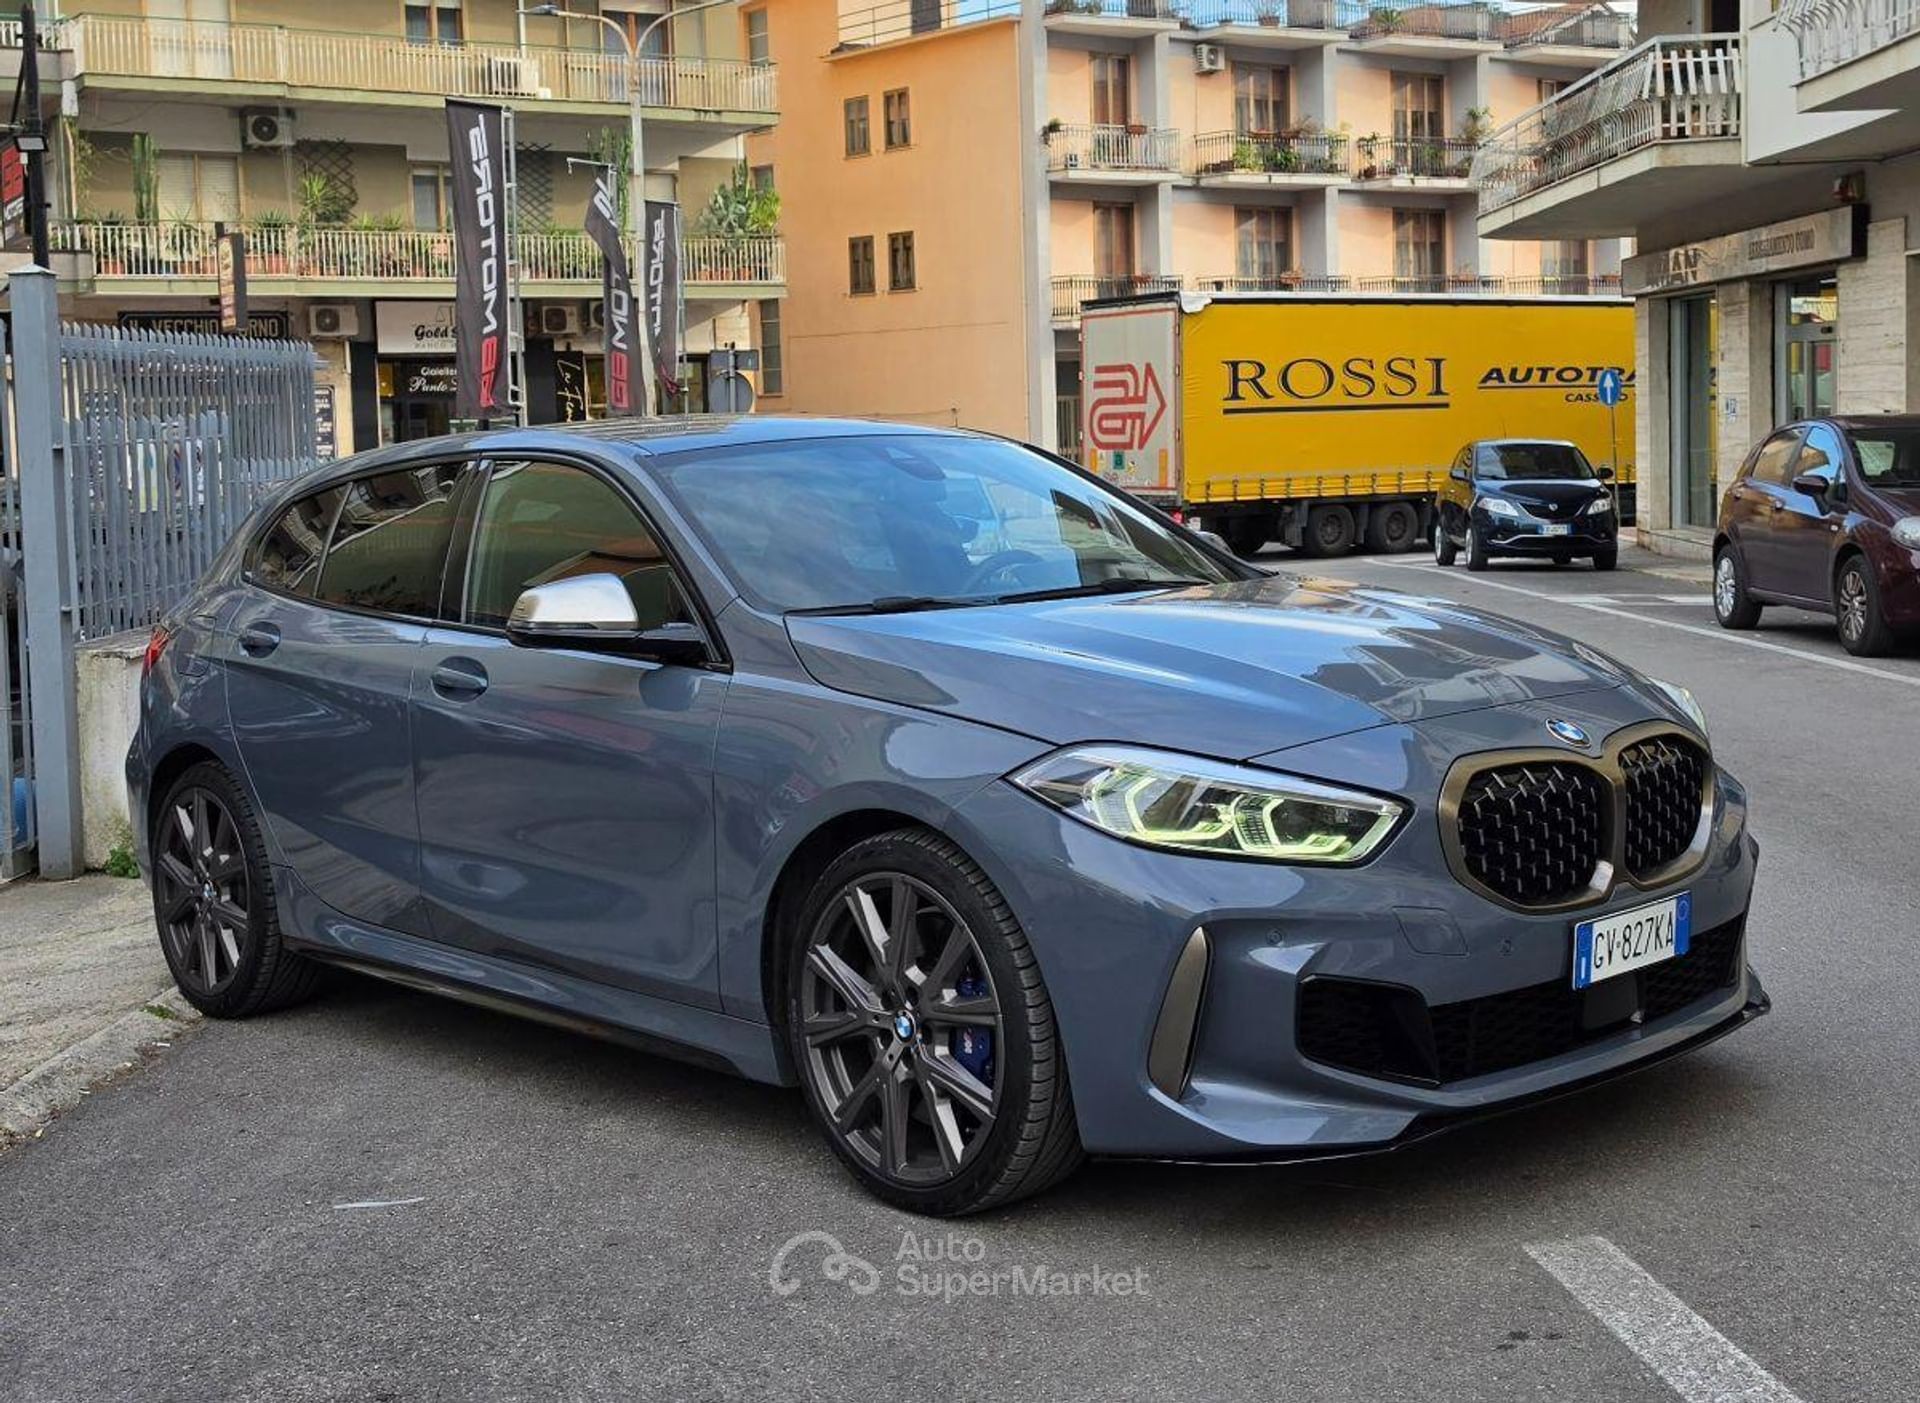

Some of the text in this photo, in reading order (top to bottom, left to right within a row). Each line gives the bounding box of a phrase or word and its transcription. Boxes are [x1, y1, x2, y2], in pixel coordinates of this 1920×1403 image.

[152, 319, 219, 336] VECCHIO
[414, 325, 448, 340] Gold
[409, 375, 448, 392] Punto
[1221, 356, 1449, 401] ROSSI
